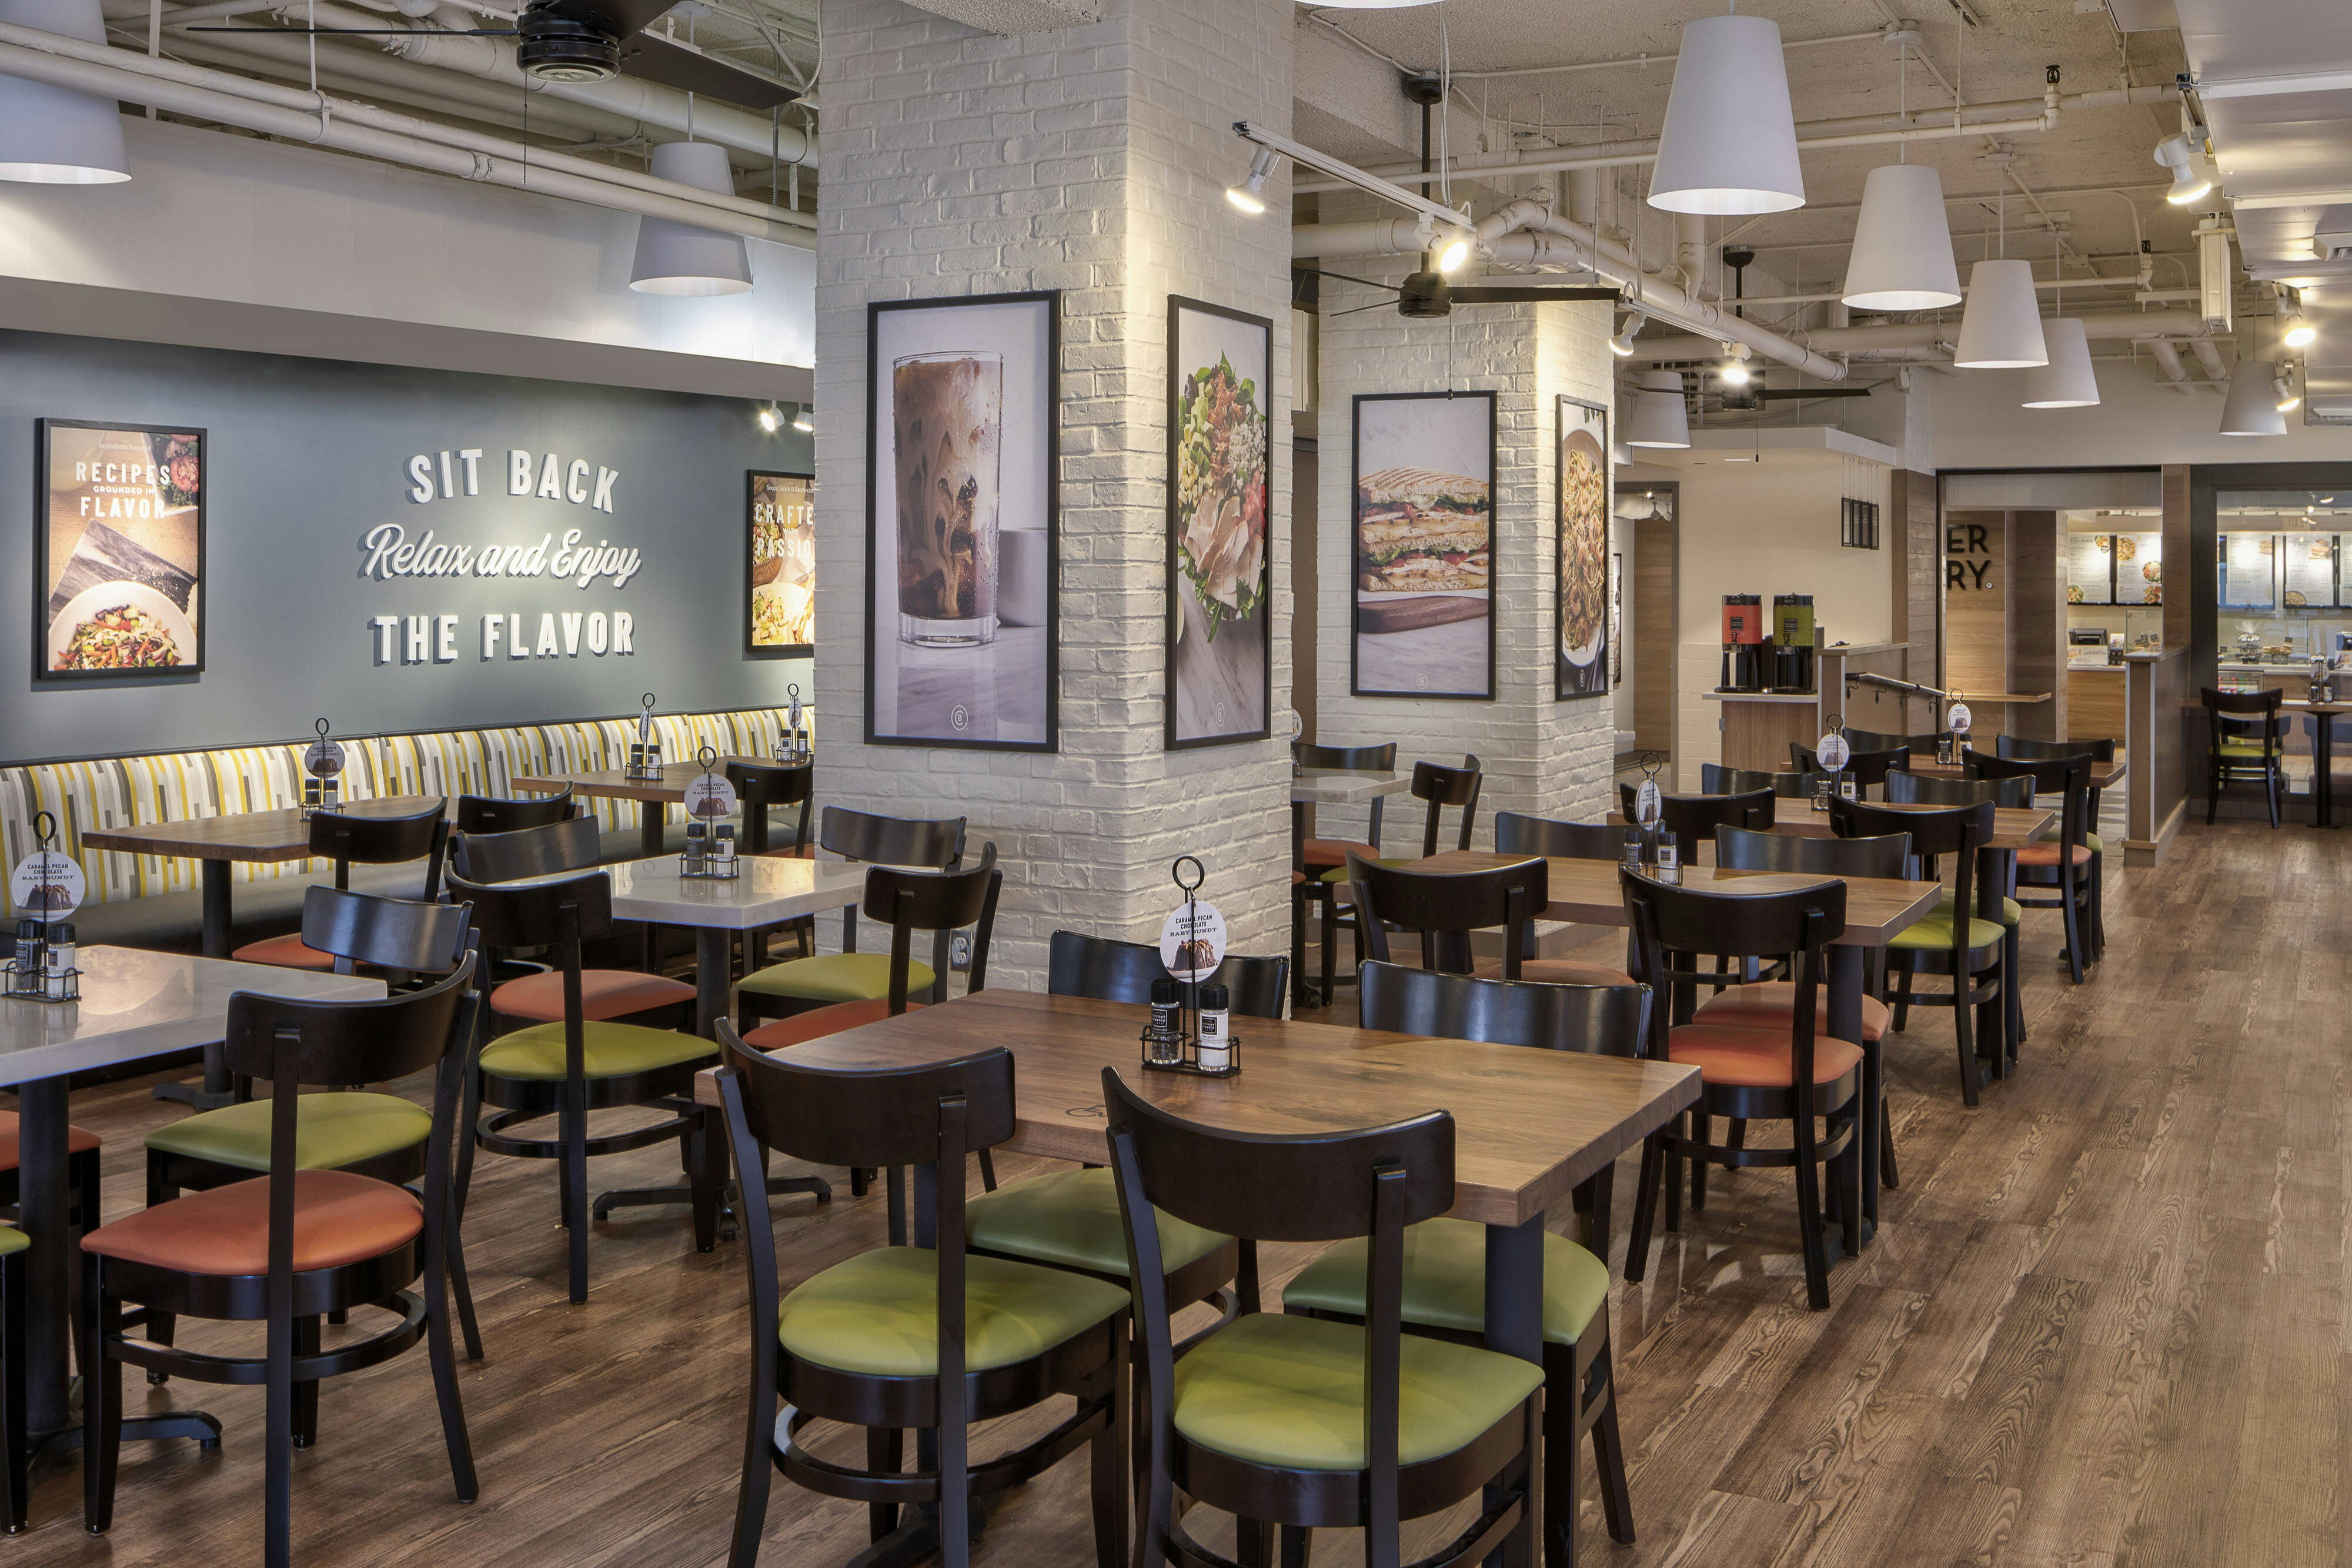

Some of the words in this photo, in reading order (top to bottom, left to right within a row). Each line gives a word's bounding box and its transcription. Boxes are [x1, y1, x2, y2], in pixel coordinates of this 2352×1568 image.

[98, 442, 128, 450] Ingredient
[76, 461, 170, 485] RECIPES
[410, 449, 483, 503] SIT
[510, 449, 619, 514] BACK
[93, 486, 142, 494] GROUNDED
[80, 496, 165, 519] FLAVOR
[755, 504, 814, 525] CRAFTE
[365, 523, 474, 579] Relax
[476, 533, 552, 576] and
[550, 529, 641, 588] Enjoy
[757, 538, 811, 557] PASSIO
[374, 614, 459, 662] THE
[484, 611, 634, 658] FLAVOR
